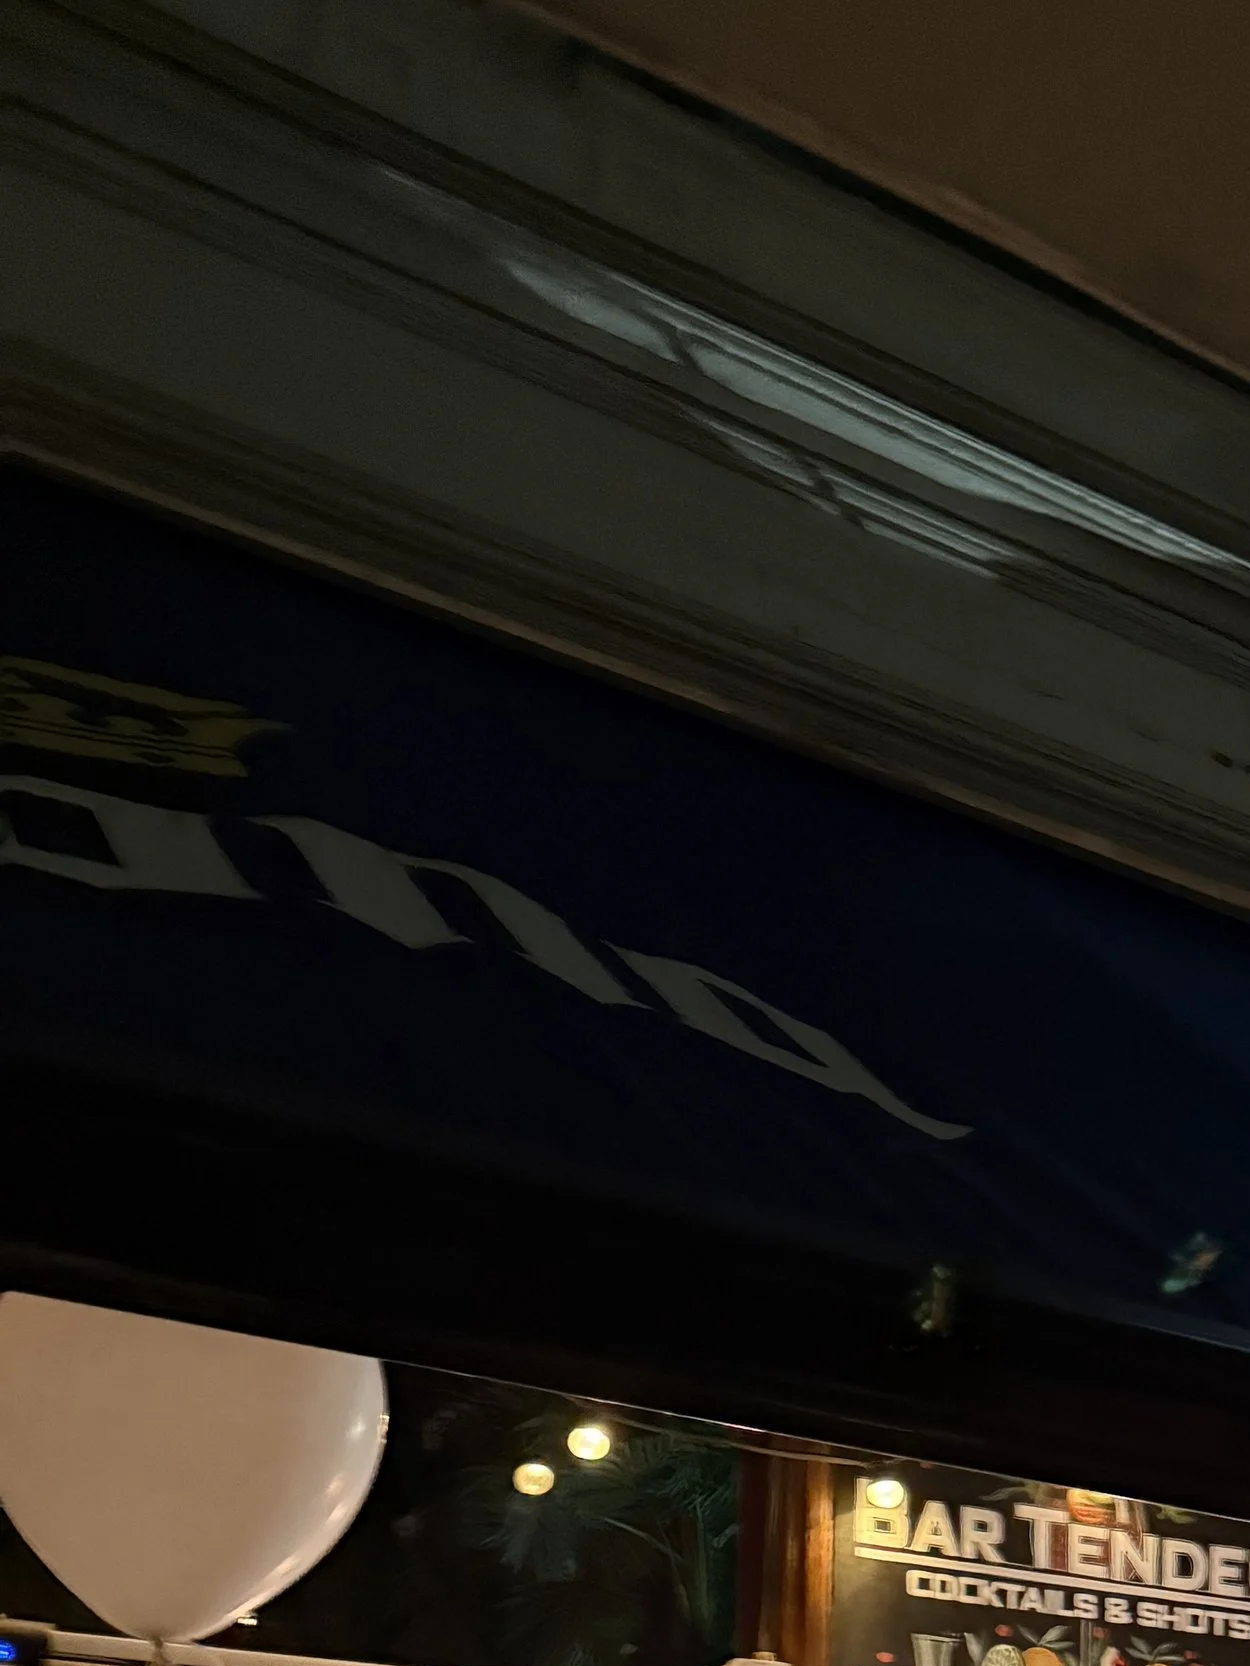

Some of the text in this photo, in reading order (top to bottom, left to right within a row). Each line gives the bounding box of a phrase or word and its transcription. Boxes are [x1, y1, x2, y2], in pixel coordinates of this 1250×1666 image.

[853, 1476, 1007, 1563] BAR
[905, 1569, 1099, 1620] COCKTAILS
[1104, 1597, 1133, 1624] &
